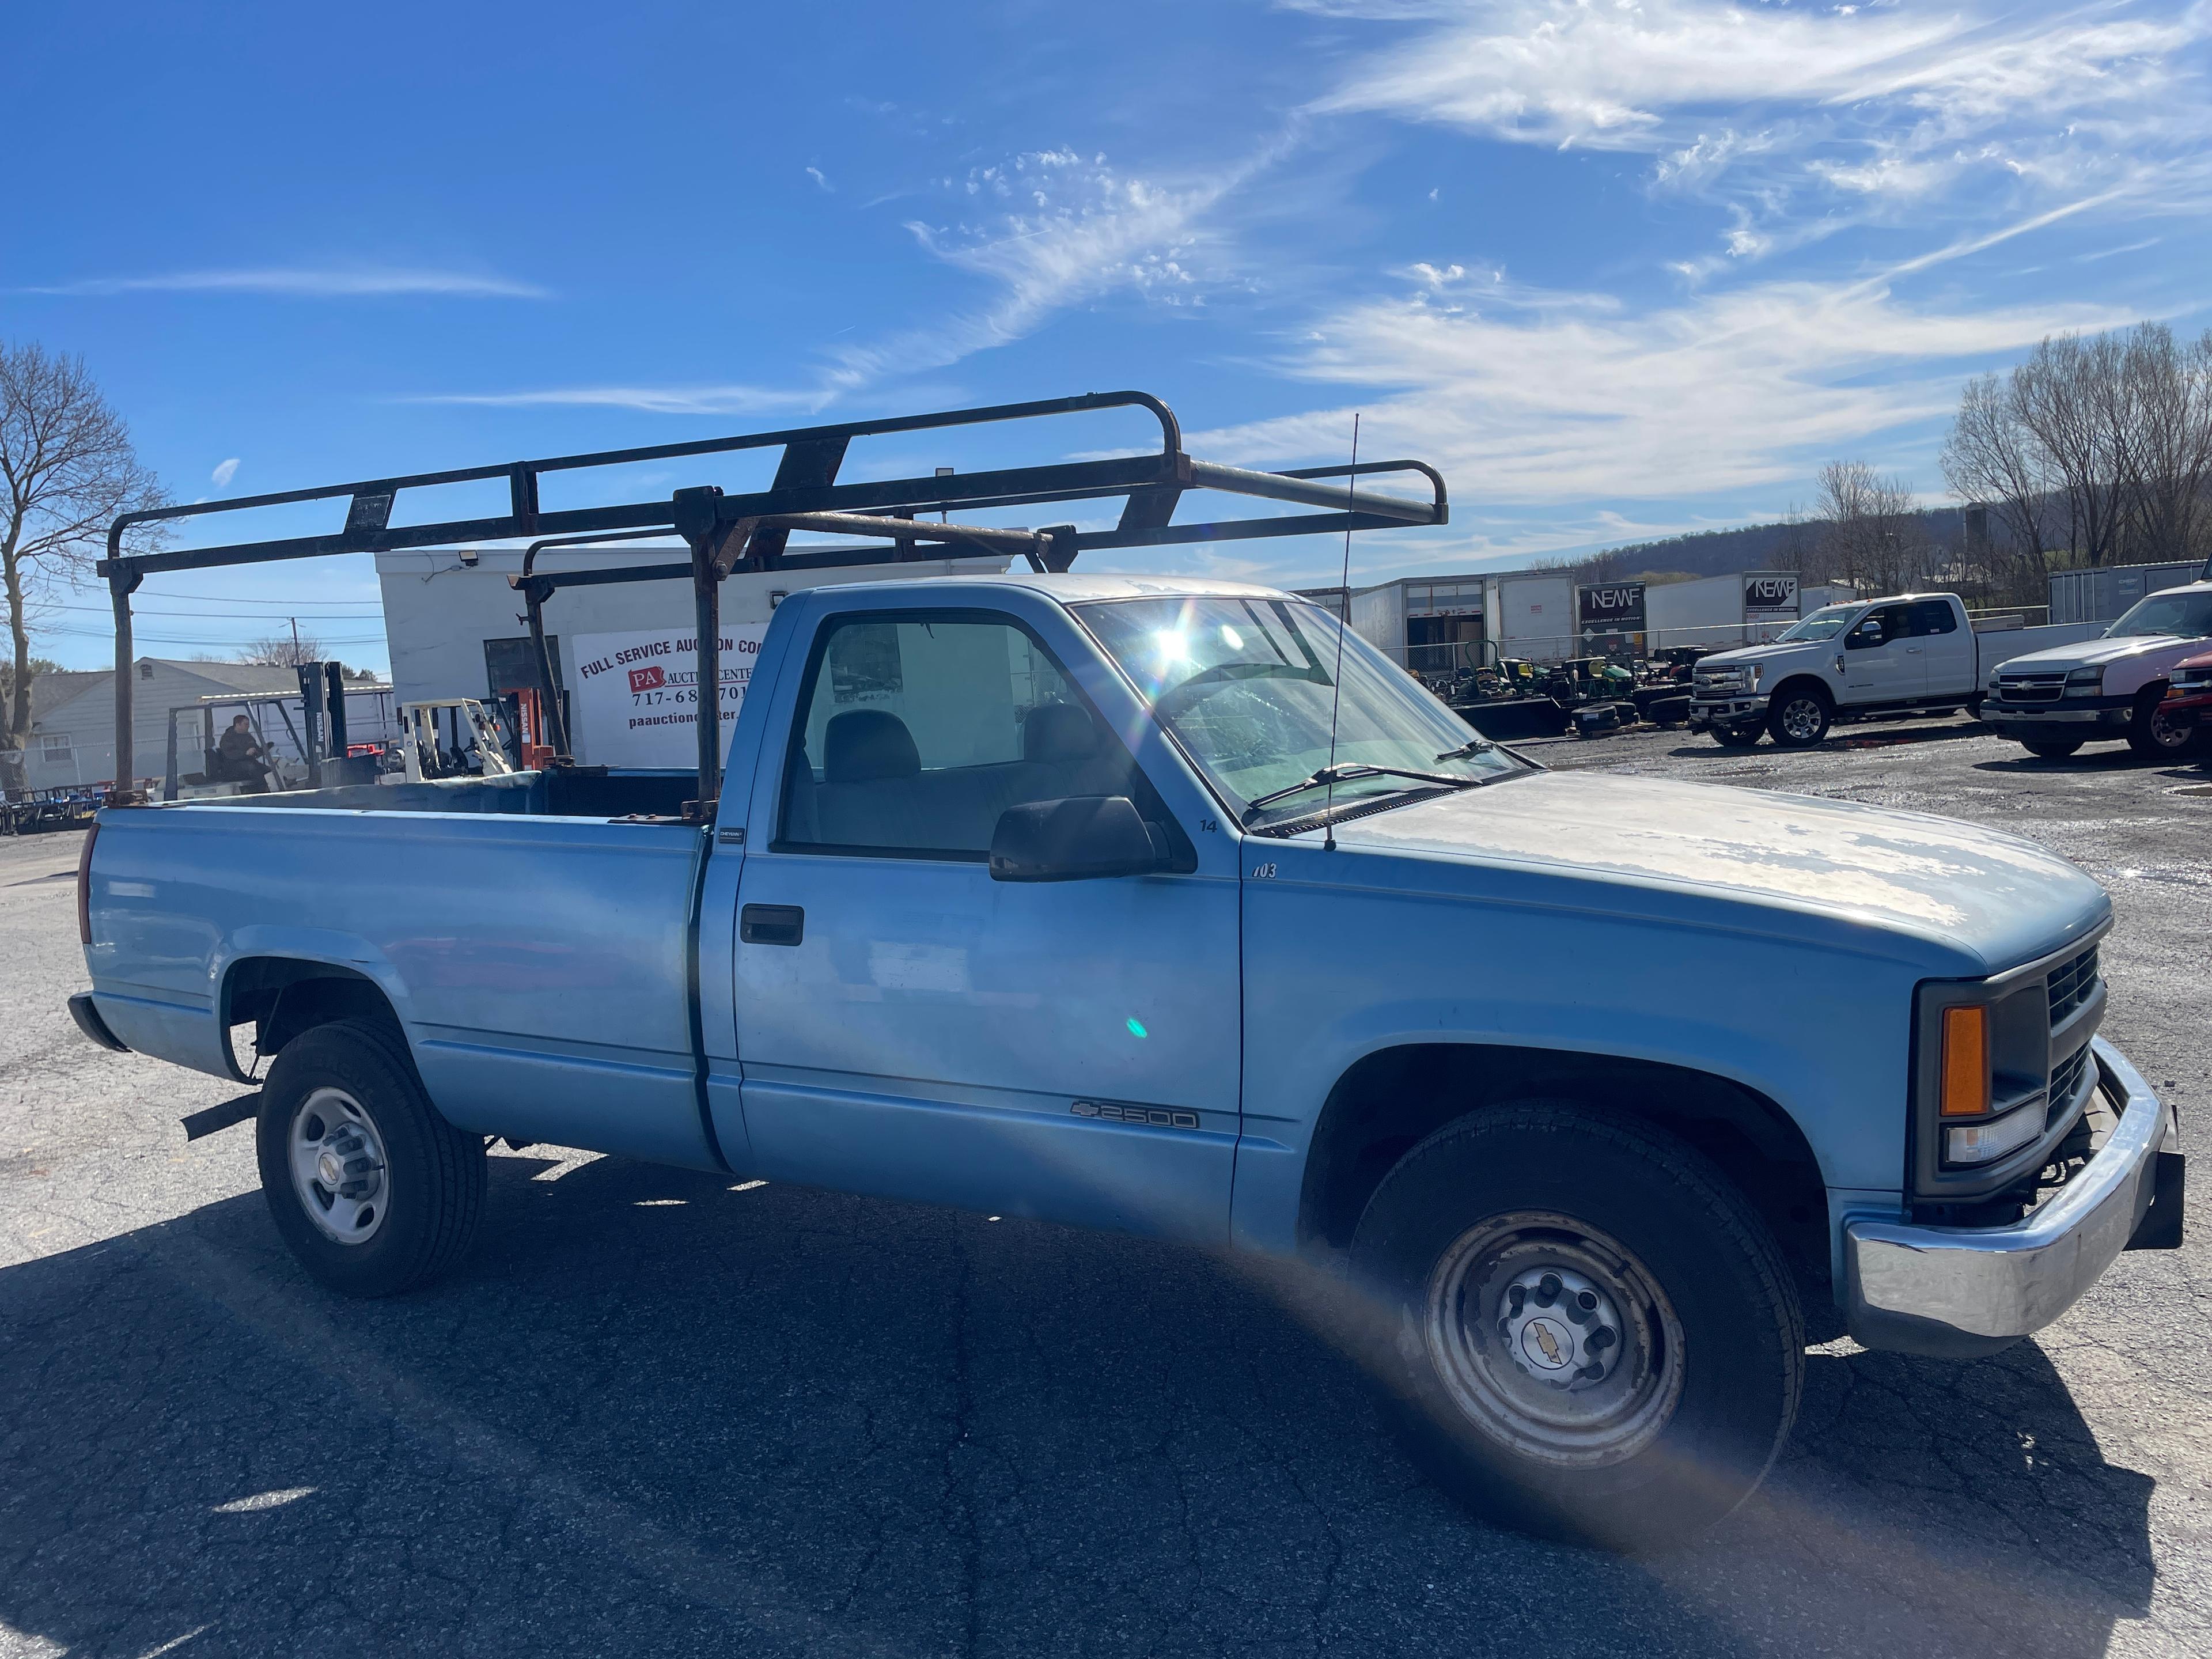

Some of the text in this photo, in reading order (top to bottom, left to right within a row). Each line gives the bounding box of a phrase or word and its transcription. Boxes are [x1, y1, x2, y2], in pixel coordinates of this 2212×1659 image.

[1591, 588, 1640, 608] NEMF
[1755, 580, 1795, 597] NEMF
[581, 638, 762, 679] FULL SERVICE AUCON CO
[632, 671, 657, 687] PA
[719, 668, 754, 680] CENTE
[1200, 819, 1217, 833] 14
[1100, 1104, 1199, 1128] 2500
